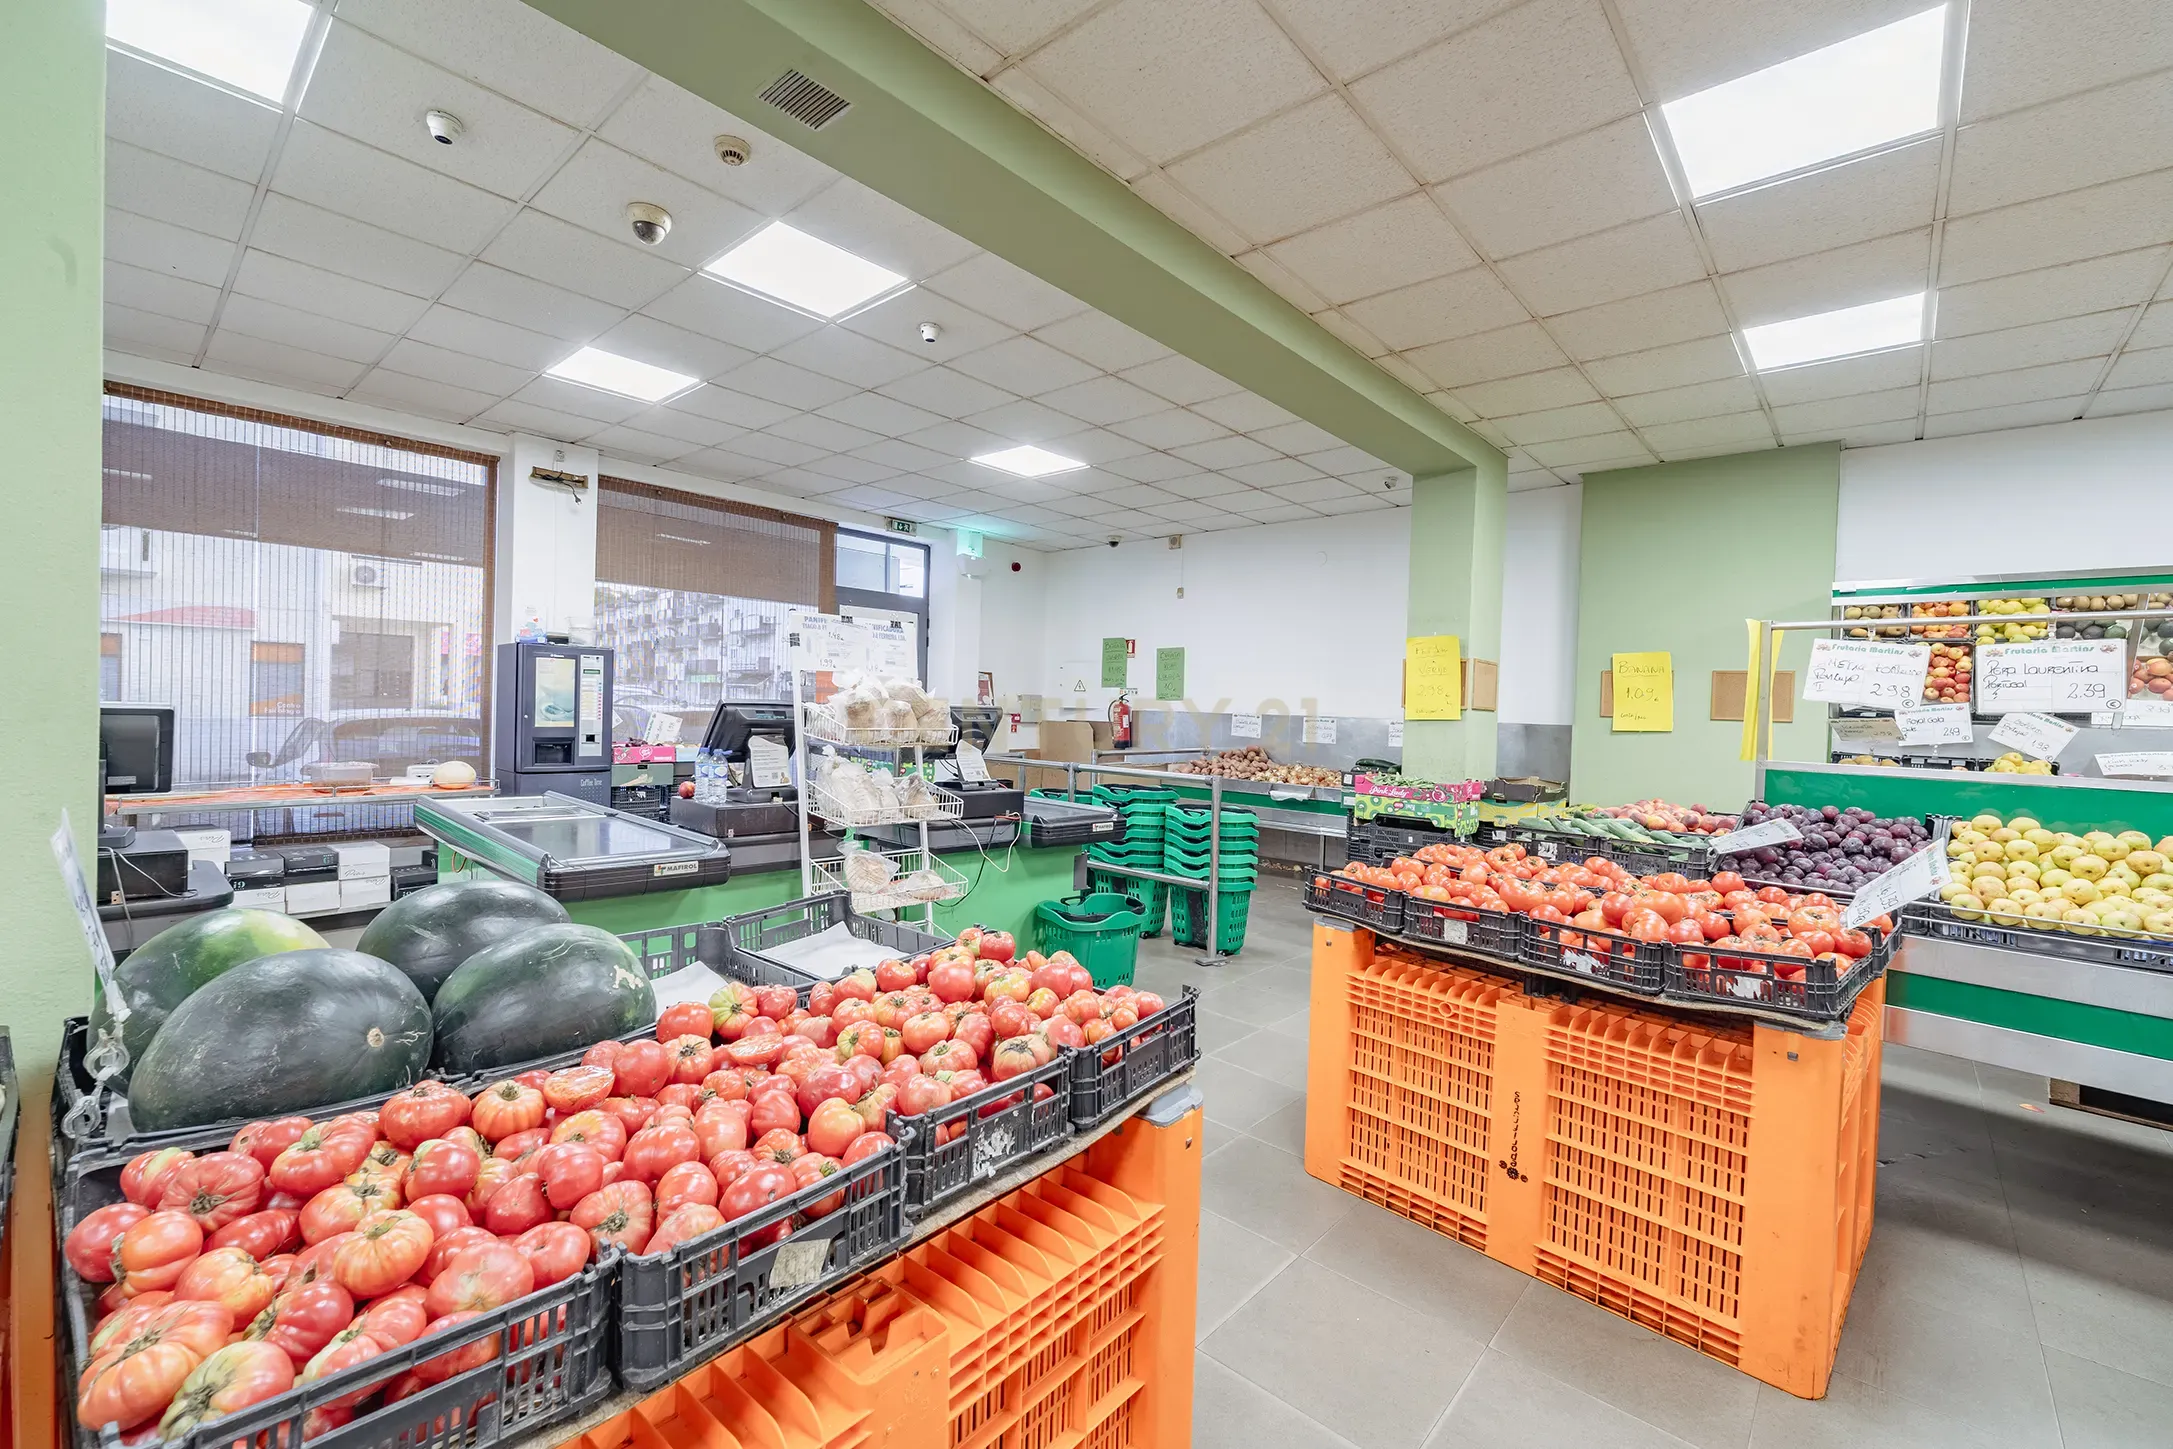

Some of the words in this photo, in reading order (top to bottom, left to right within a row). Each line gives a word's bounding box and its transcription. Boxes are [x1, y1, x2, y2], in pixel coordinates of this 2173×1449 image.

[1831, 643, 1867, 652] Frutaria
[1869, 646, 1904, 655] Martins
[2004, 647, 2048, 655] Frutaria
[1369, 784, 1389, 795] Pink
[1389, 788, 1410, 799] Lady
[667, 864, 698, 872] MAFIROL
